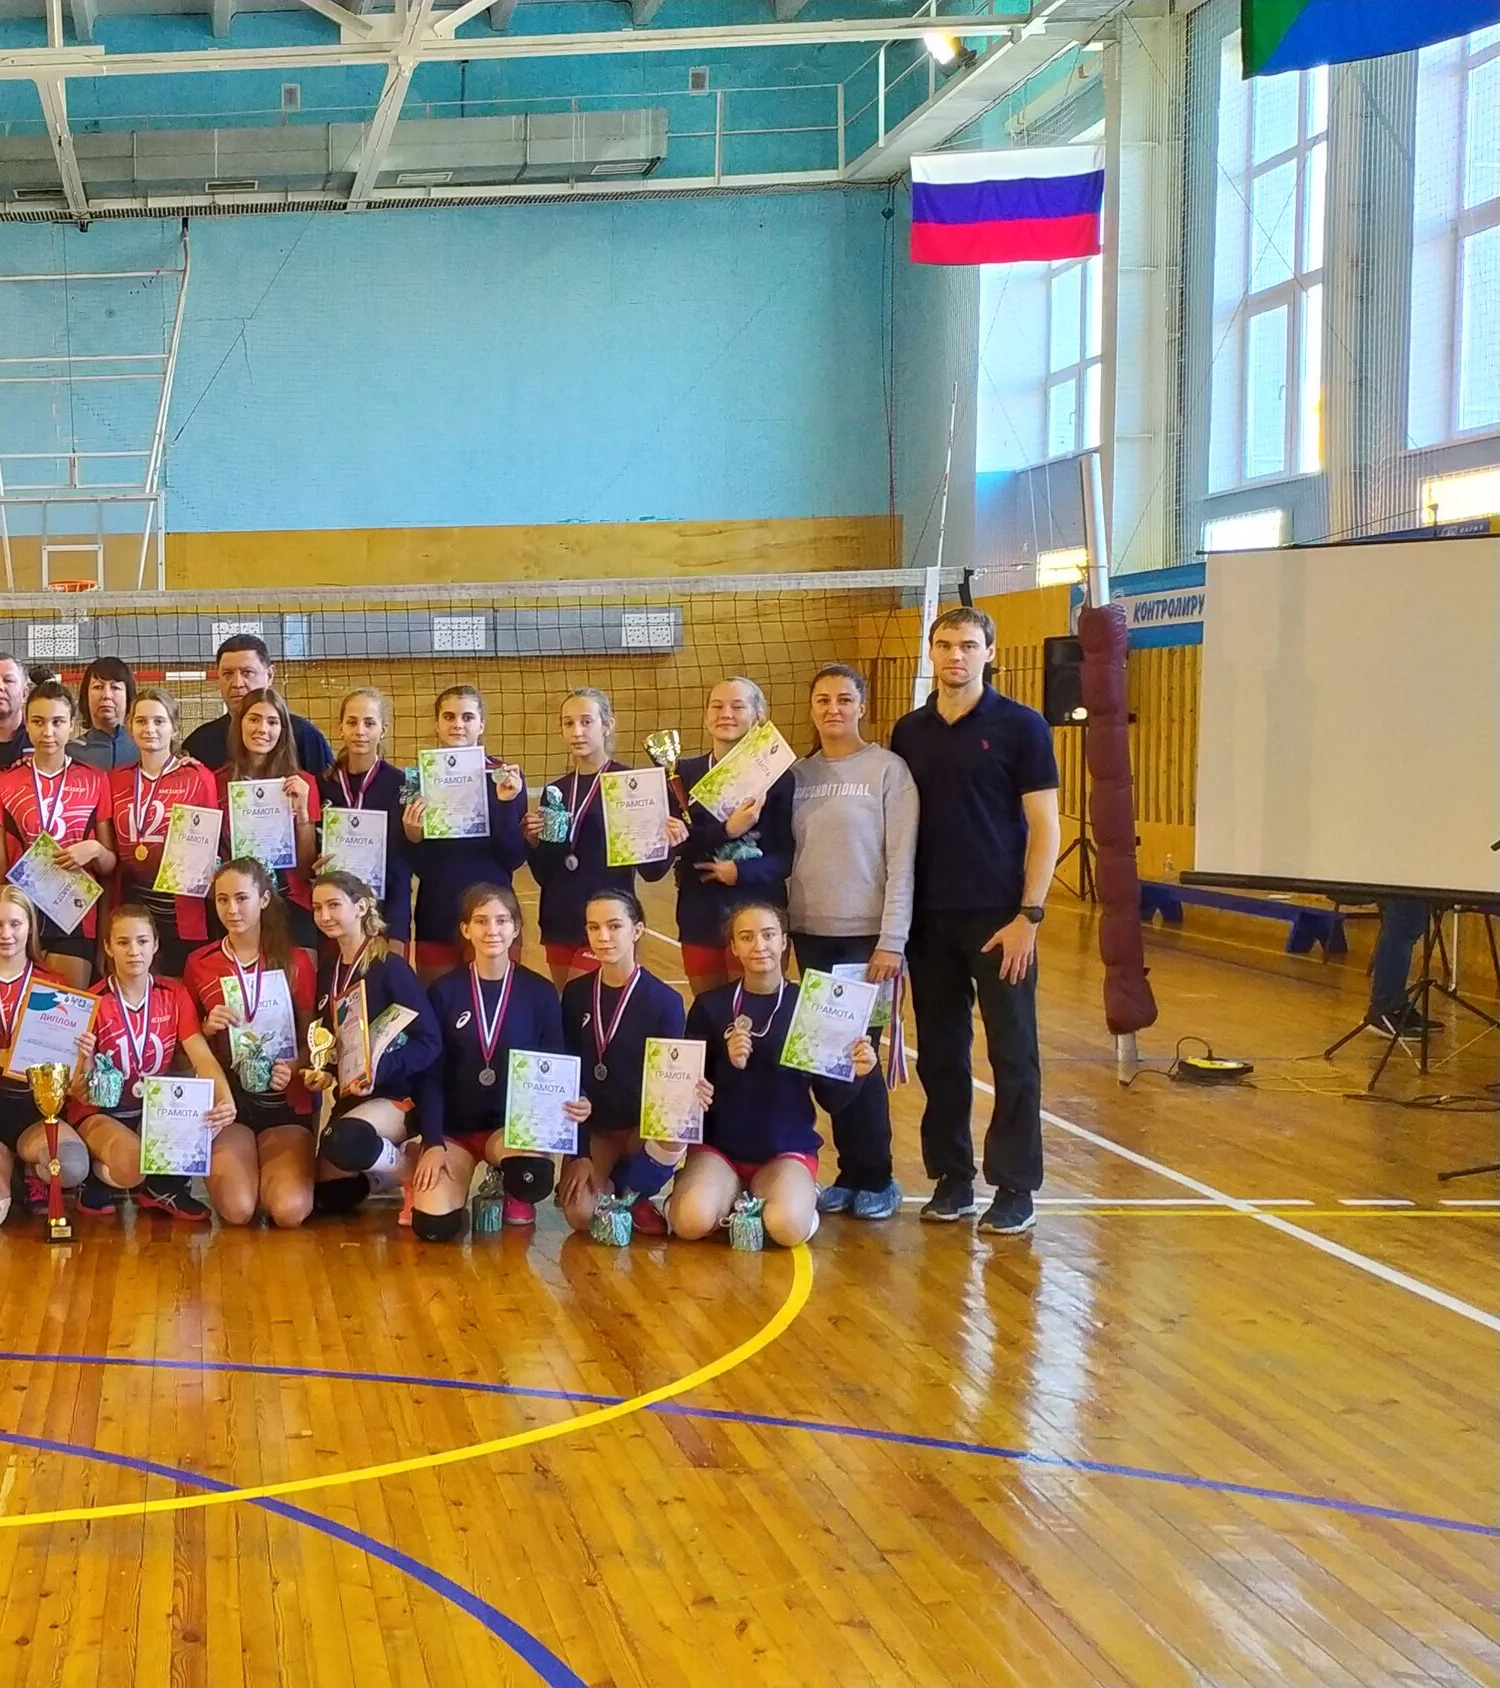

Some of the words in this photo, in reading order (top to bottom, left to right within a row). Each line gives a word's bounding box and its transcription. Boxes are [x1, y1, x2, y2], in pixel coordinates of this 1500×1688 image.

[1133, 593, 1206, 623] КОНТРОЛИРУ
[433, 775, 474, 785] ГРАМОТА
[615, 798, 655, 809] ГРАМОТА
[242, 807, 280, 817] ГРАМОТА
[177, 833, 210, 845] ГРАМОТА
[334, 836, 374, 846] ГРАМОТА
[52, 873, 78, 905] ГРАМОТА
[811, 1003, 855, 1020] ГРАМОТА
[39, 1012, 77, 1028] ДИПЛОМ
[655, 1070, 691, 1081] ГРАМОТА
[522, 1082, 566, 1093] ГРАМОТА
[156, 1108, 199, 1117] ГРАМОТА
